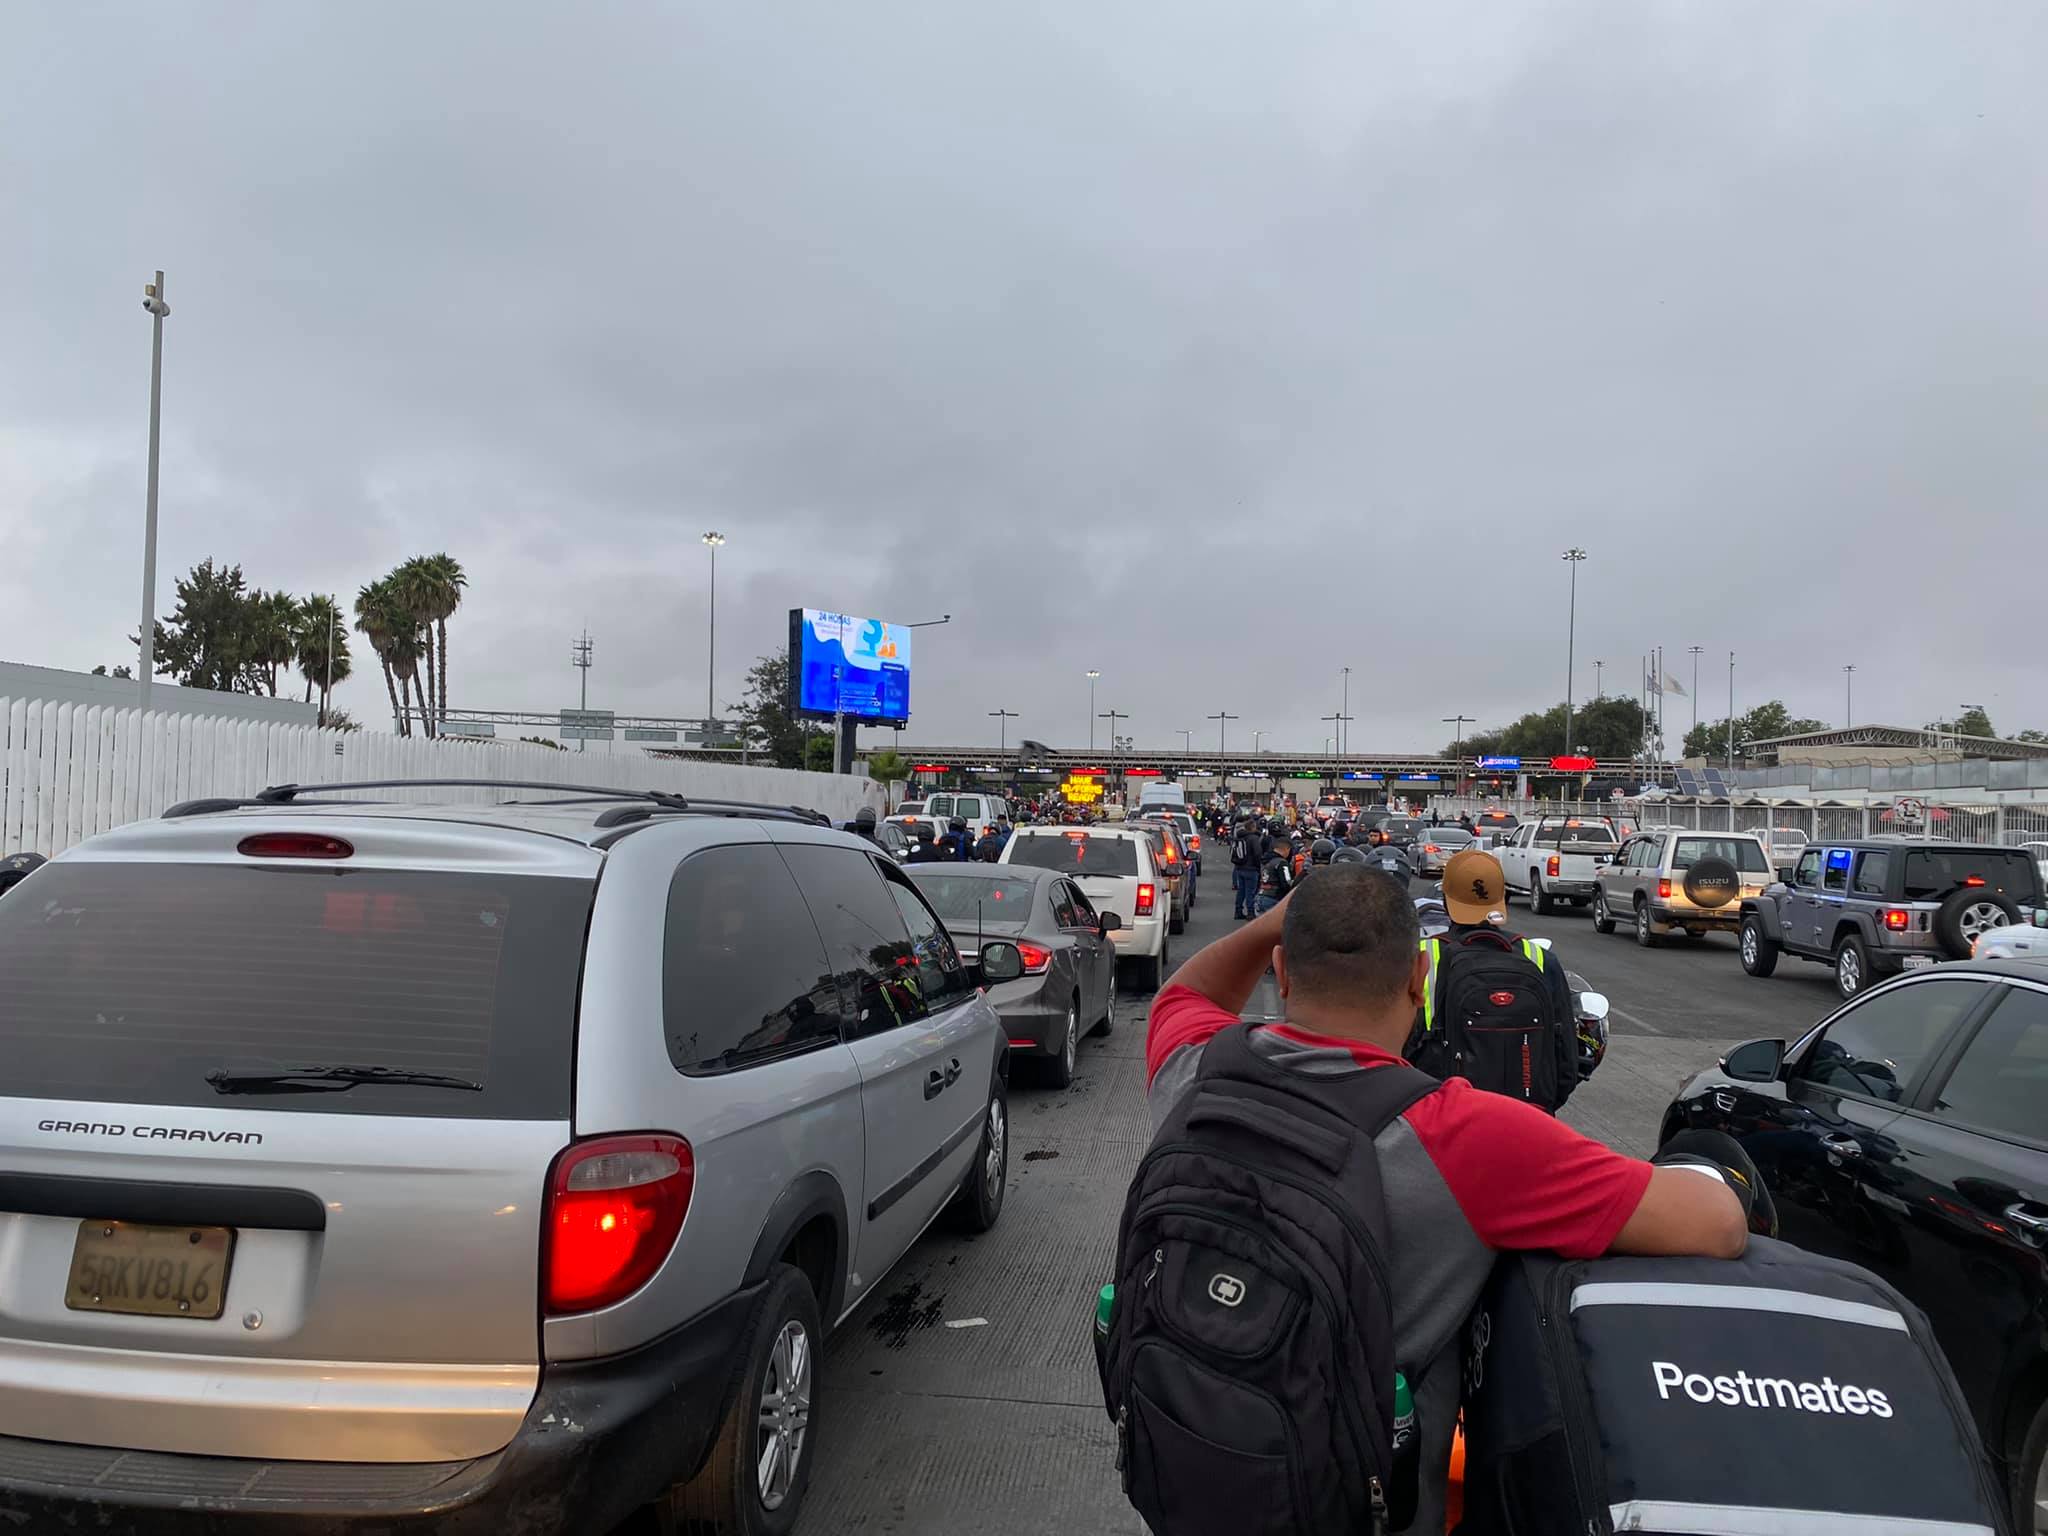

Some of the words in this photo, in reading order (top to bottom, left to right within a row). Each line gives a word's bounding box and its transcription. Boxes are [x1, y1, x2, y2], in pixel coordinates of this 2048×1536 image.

[818, 612, 827, 621] 24
[1070, 776, 1092, 785] HAVE
[1067, 793, 1096, 802] READY
[38, 1120, 126, 1136] GRAND
[132, 1126, 263, 1145] CARAVAN
[79, 1254, 213, 1303] 5RKV816
[1651, 1360, 1894, 1419] Postmates
